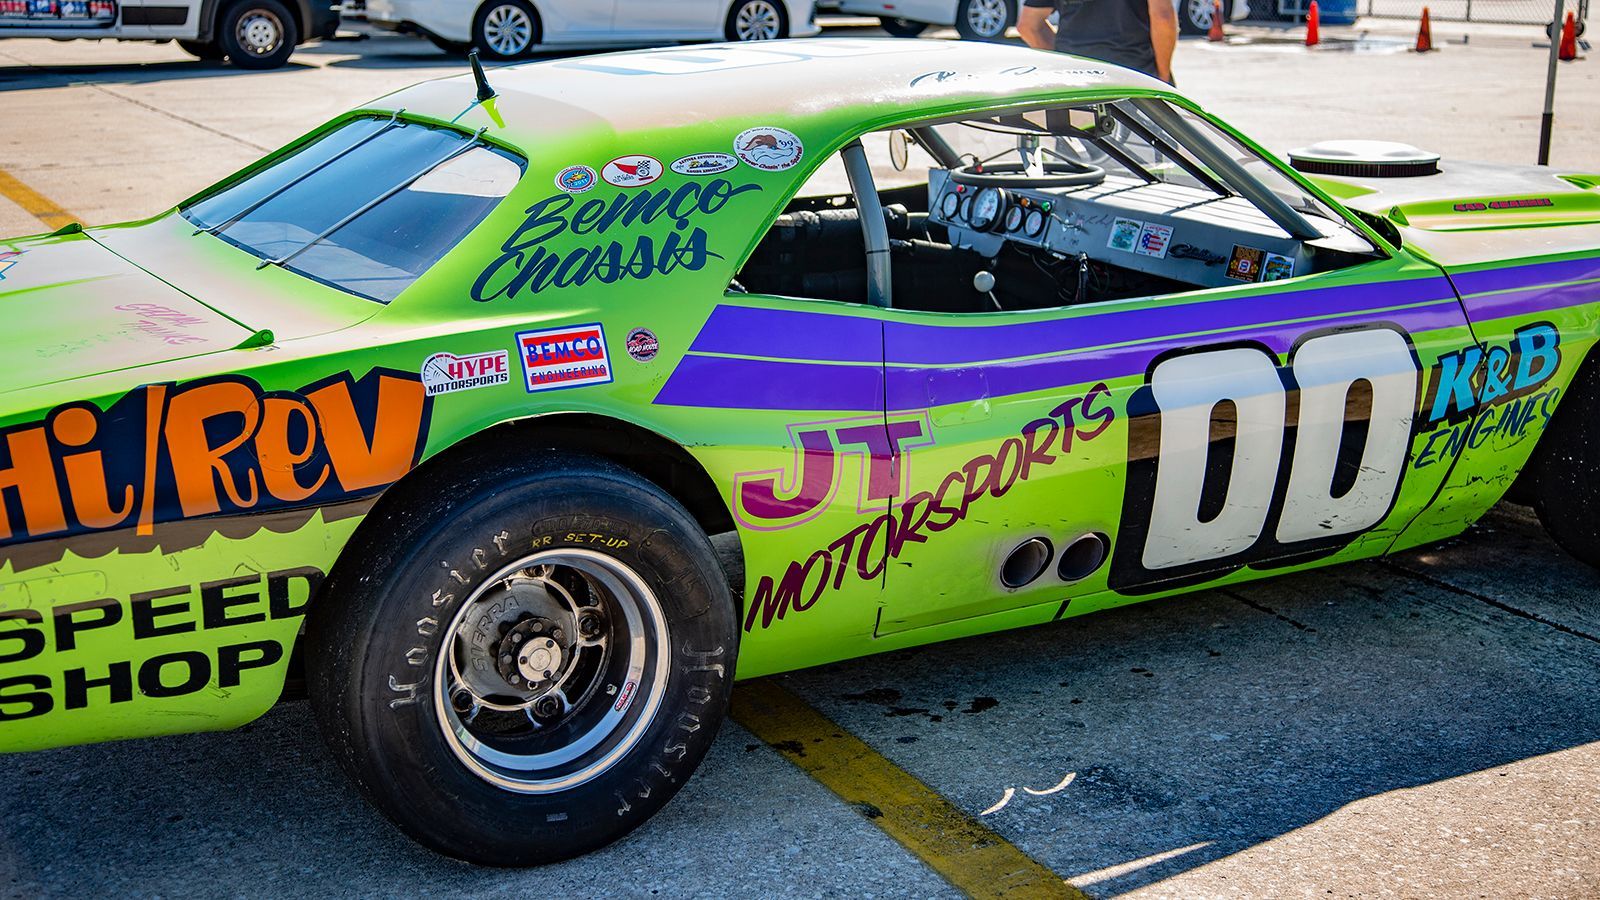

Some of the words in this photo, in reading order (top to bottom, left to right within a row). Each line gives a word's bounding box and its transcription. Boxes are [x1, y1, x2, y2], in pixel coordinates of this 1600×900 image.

[738, 153, 759, 166] Forever
[778, 139, 794, 148] '99
[501, 179, 763, 252] Bemco
[470, 220, 725, 302] Chassis
[428, 372, 508, 394] MOTORSPORTS
[448, 354, 506, 380] HYPE
[526, 335, 601, 363] BEMCO
[531, 364, 606, 385] ENGINEERING
[1425, 323, 1561, 424] K&B
[1140, 327, 1419, 570] 00
[1414, 387, 1560, 470] ENGINES
[737, 415, 929, 524] JT
[744, 382, 1114, 633] MOTORSPORTS
[532, 536, 552, 549] RR
[564, 533, 629, 549] SET-UP
[0, 565, 326, 664] SPEED
[388, 530, 509, 709] Hoosier
[471, 595, 520, 672] SIERRA
[0, 639, 284, 722] SHOP
